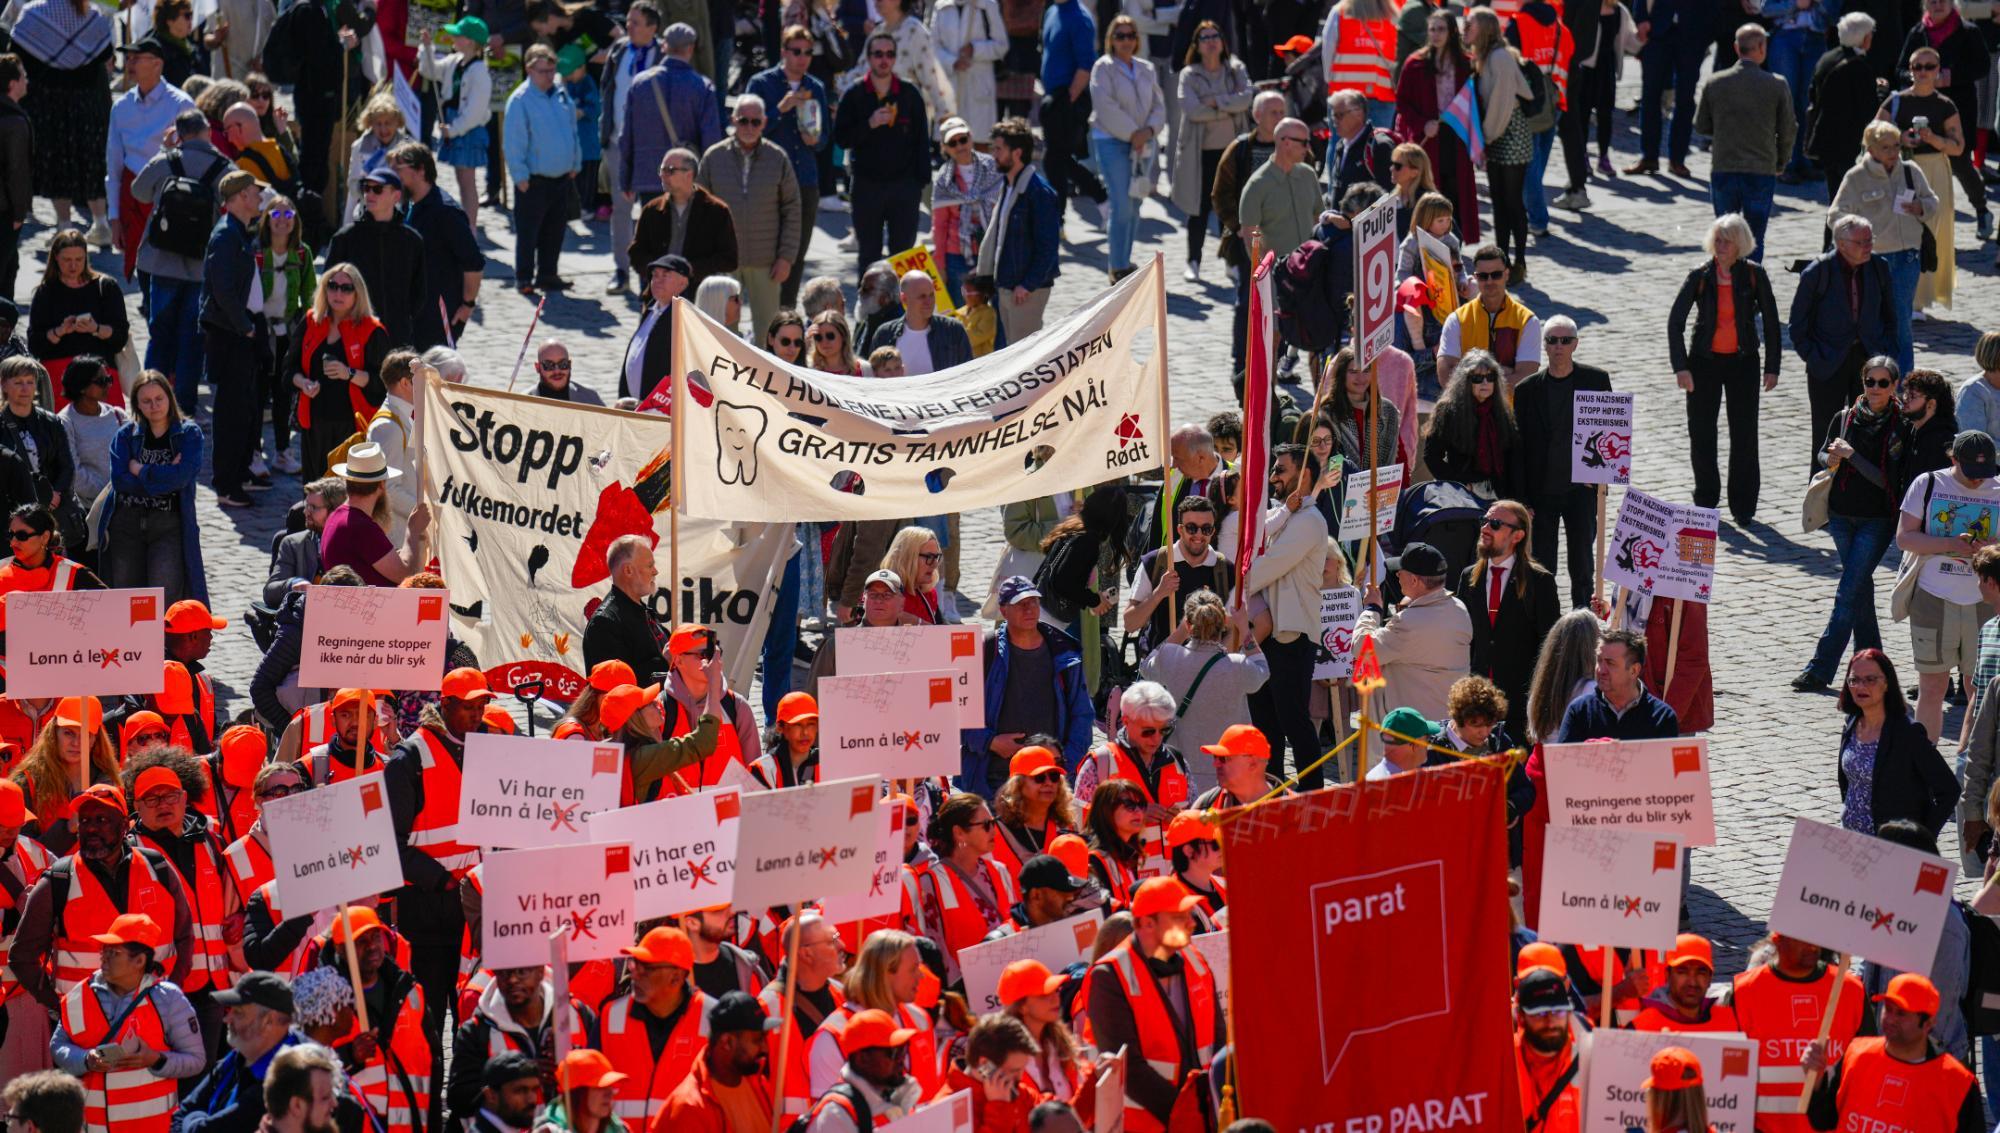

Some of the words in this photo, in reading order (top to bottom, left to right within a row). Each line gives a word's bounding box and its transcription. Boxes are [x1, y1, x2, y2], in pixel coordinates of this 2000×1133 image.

[1362, 206, 1394, 243] Pulje
[1368, 250, 1390, 322] 9
[710, 356, 778, 394] FYLL
[896, 405, 907, 420] I
[909, 329, 1113, 420] VELFERDSSTATEN
[1596, 396, 1632, 404] NAZISMEN!
[778, 428, 896, 464] GRATIS
[905, 402, 1059, 463] TANNHELSE
[1062, 378, 1108, 422] NÅ!
[1580, 406, 1600, 414] STOPP
[1602, 408, 1626, 416] HØYRE-
[1578, 418, 1628, 427] EKSTREMISMEN
[450, 402, 584, 490] Stopp
[1106, 442, 1150, 469] Rødt
[1626, 492, 1642, 504] KNUS
[1626, 504, 1644, 517] STOPP
[1622, 515, 1666, 540] EKSTREMISMEN
[318, 636, 385, 650] Regningene
[388, 638, 432, 652] stopper
[29, 652, 68, 666] Lønn
[72, 650, 83, 664] å
[123, 650, 142, 662] av
[320, 652, 342, 663] ikke
[346, 653, 364, 664] når
[368, 654, 383, 664] du
[386, 654, 404, 665] blir
[407, 655, 426, 668] syk
[840, 736, 874, 749] Lønn
[879, 733, 888, 746] å
[924, 733, 940, 743] av
[499, 778, 518, 796] Vi
[524, 780, 556, 798] har
[562, 788, 584, 800] en
[470, 798, 512, 817] lønn
[519, 802, 530, 819] å
[1566, 796, 1642, 810] Regningene
[1646, 794, 1695, 806] stopper
[1572, 814, 1597, 826] ikke
[1601, 813, 1622, 824] når
[1626, 812, 1642, 823] du
[1646, 811, 1666, 822] blir
[1670, 809, 1692, 822] syk
[294, 860, 325, 878] Lønn
[328, 854, 336, 869] å
[366, 844, 380, 857] av
[634, 850, 650, 867] Vi
[656, 846, 687, 862] har
[693, 840, 715, 855] en
[756, 856, 790, 873] Lønn
[795, 852, 804, 866] å
[840, 846, 857, 860] av
[875, 850, 887, 863] en
[657, 869, 668, 886] å
[883, 866, 898, 885] av!
[518, 895, 536, 912] Vi
[543, 893, 573, 910] har
[579, 893, 600, 906] en
[1325, 882, 1406, 935] parat
[1562, 892, 1596, 908] Lønn
[1600, 894, 1609, 909] å
[1644, 901, 1660, 912] av
[1800, 886, 1840, 912] Lønn
[1844, 901, 1855, 916] å
[1897, 918, 1918, 934] av
[494, 920, 533, 938] lønn
[540, 916, 550, 933] å
[598, 910, 624, 928] av!
[1390, 1092, 1488, 1133] PARAT
